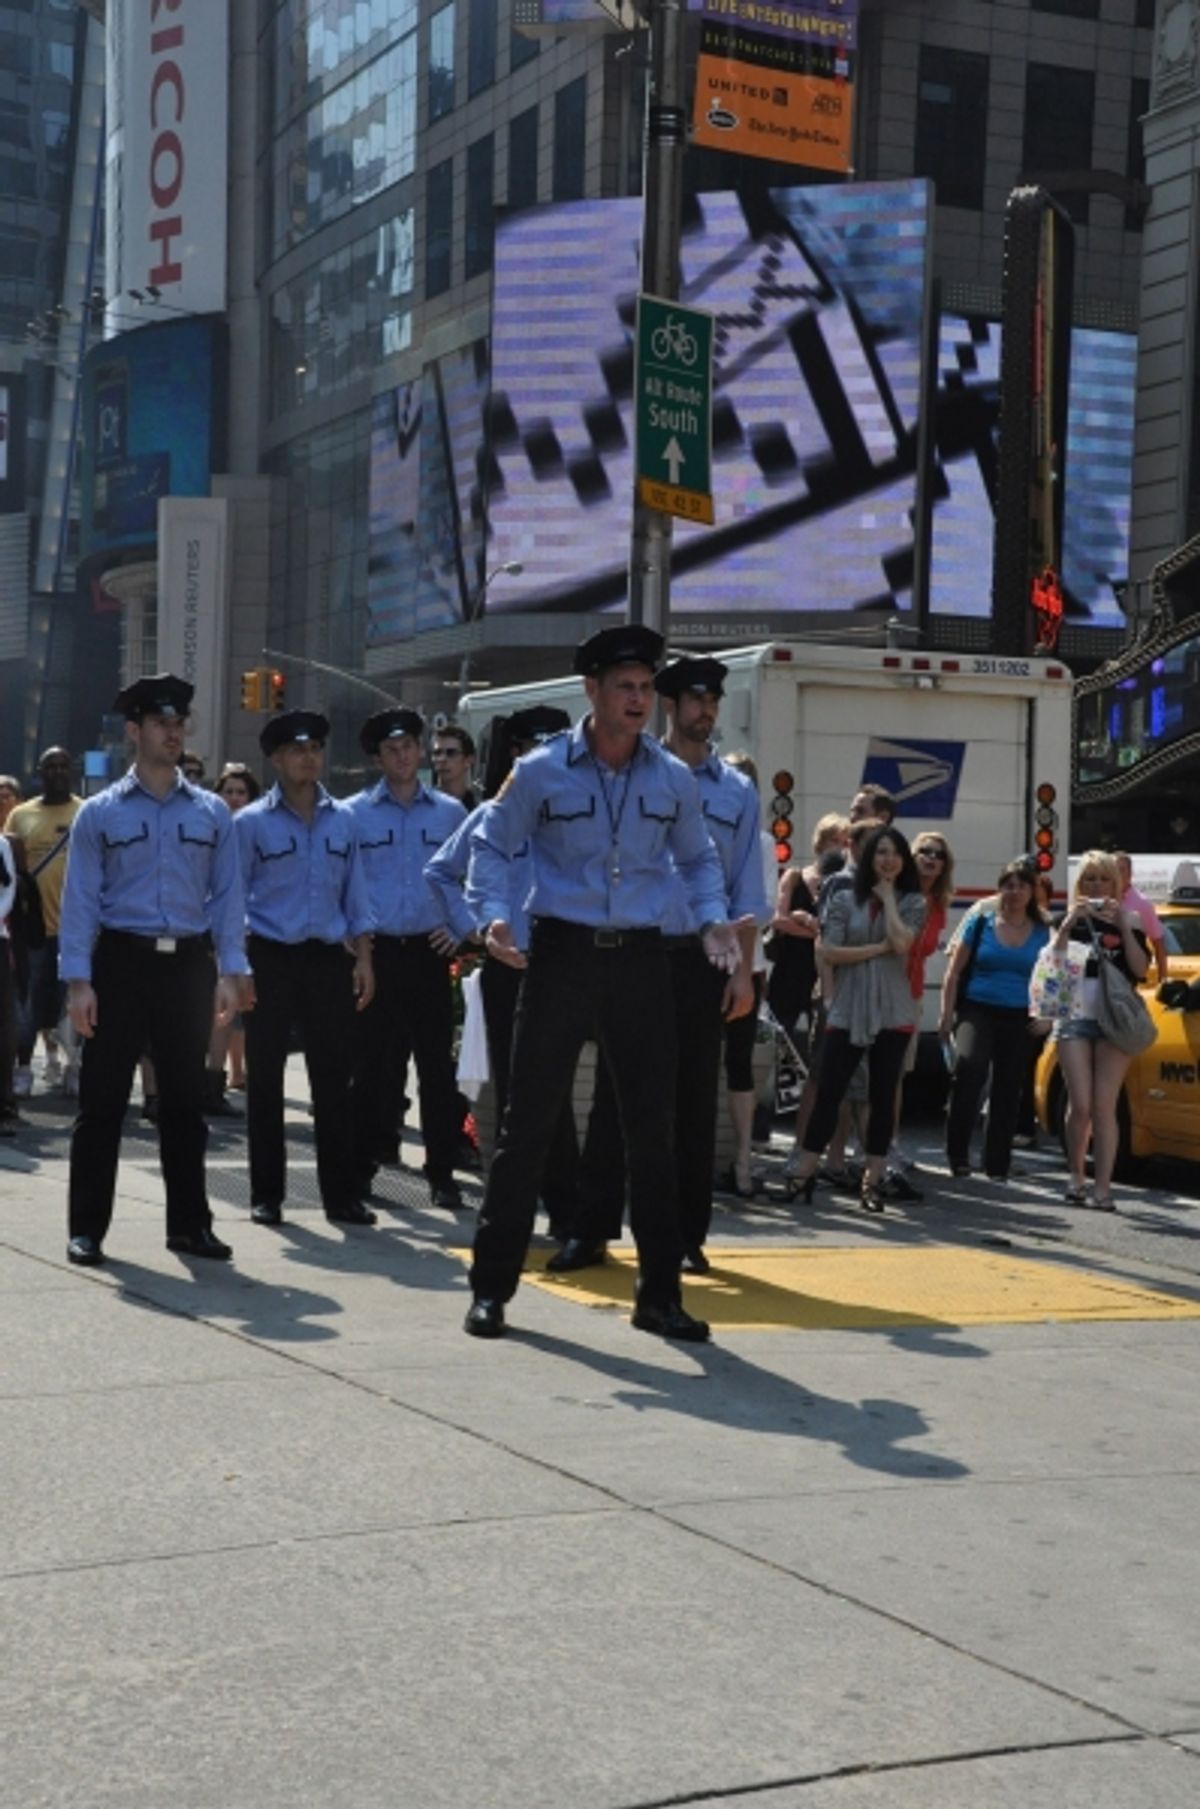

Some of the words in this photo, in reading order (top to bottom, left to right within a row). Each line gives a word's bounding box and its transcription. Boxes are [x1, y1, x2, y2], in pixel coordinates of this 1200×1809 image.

[708, 78, 770, 101] UNITED
[666, 380, 704, 406] Route
[648, 402, 699, 436] South
[185, 539, 200, 613] REUTERS
[183, 617, 198, 680] OMSON
[1160, 1061, 1195, 1084] NYC
